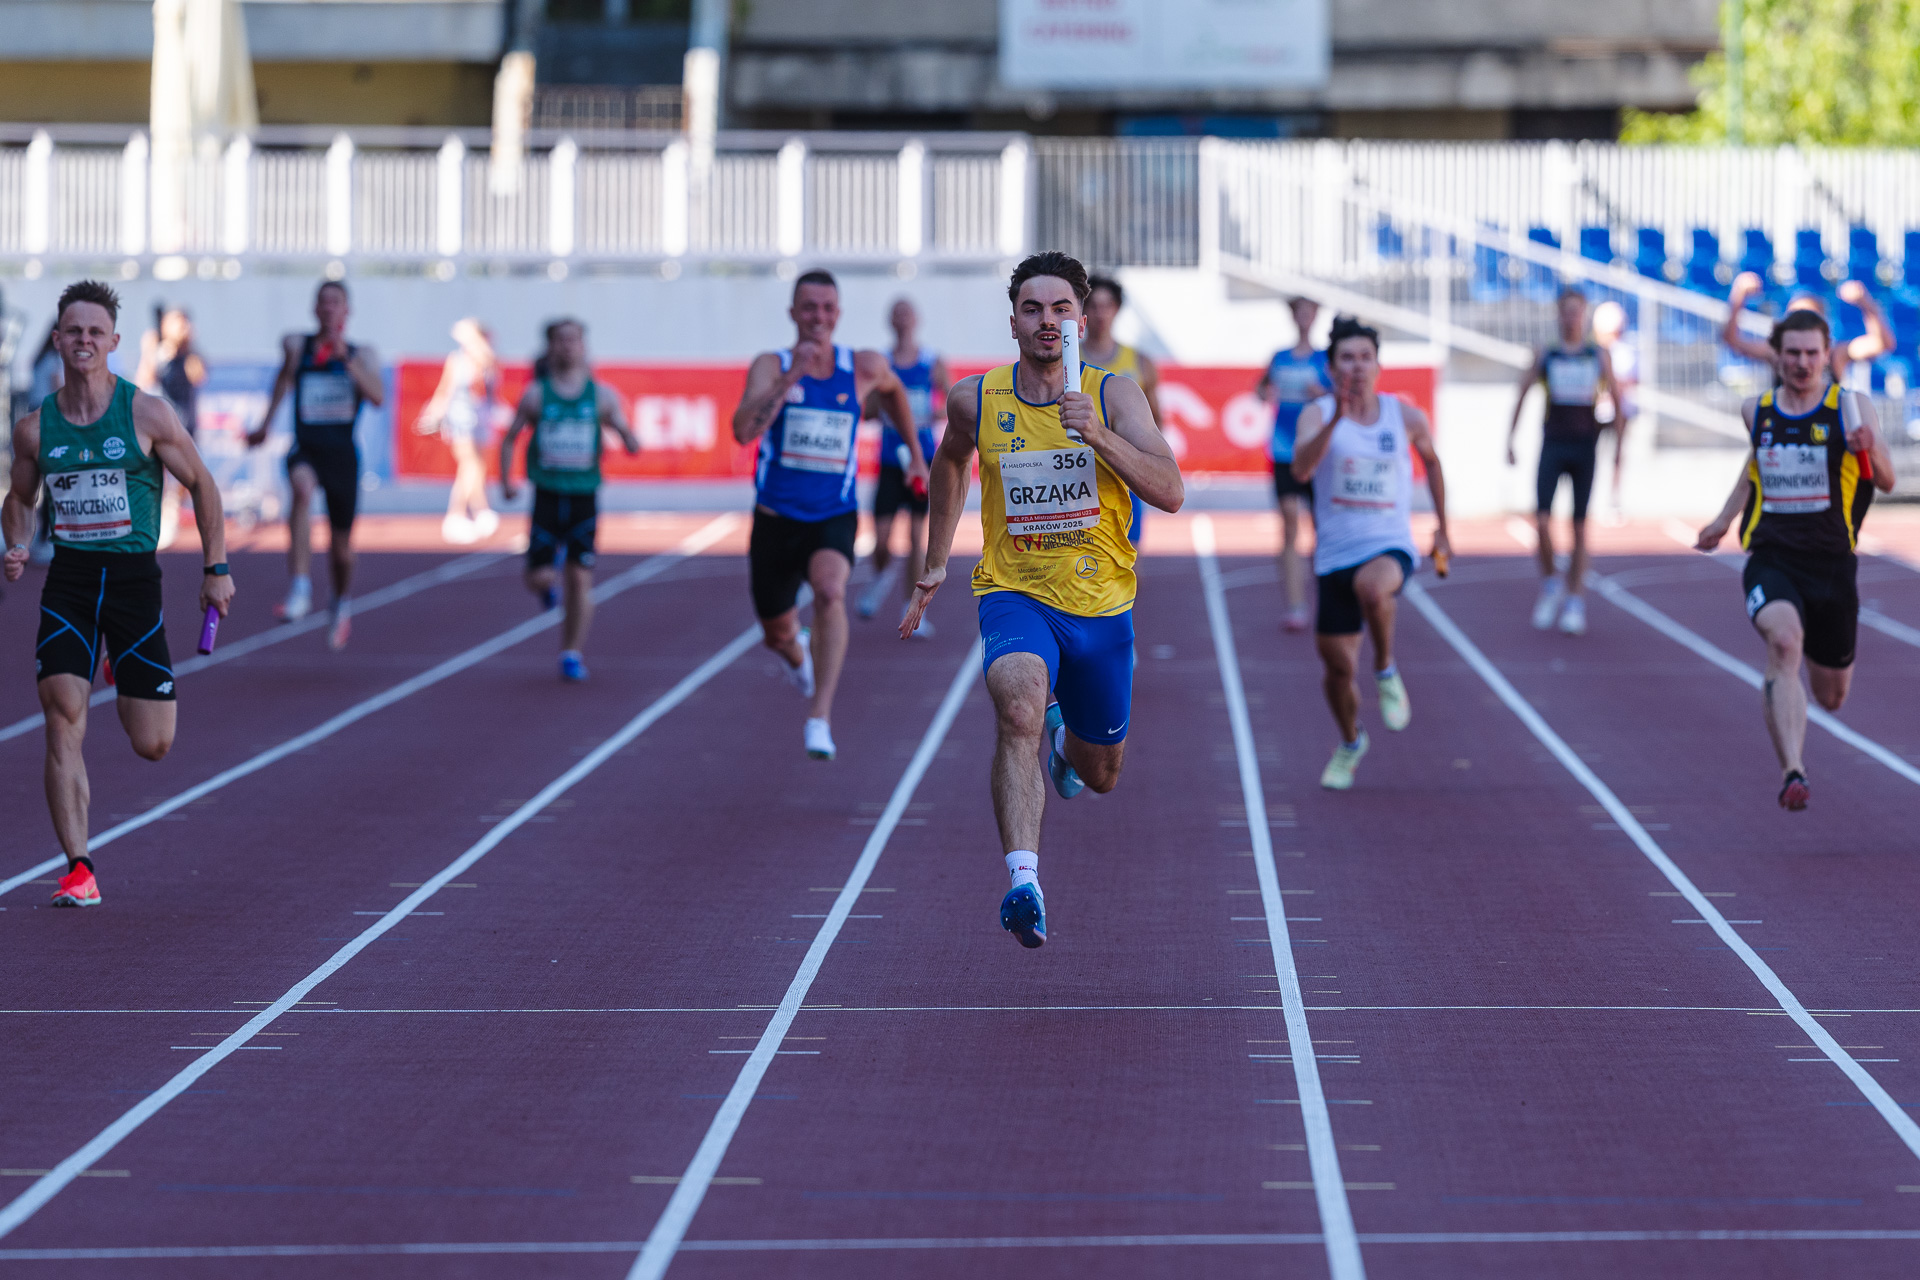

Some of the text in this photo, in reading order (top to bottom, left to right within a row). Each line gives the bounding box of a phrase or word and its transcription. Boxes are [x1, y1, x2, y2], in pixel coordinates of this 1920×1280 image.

[1063, 334, 1070, 348] 5
[1008, 461, 1043, 469] MAŁOPOLSKA
[1052, 452, 1087, 470] 356
[53, 473, 79, 491] 4F
[91, 472, 119, 487] 136
[1009, 481, 1092, 506] GRZĄKA
[1023, 520, 1083, 532] KRAKÓW 2025
[1017, 564, 1057, 574] Mercedes-Benz
